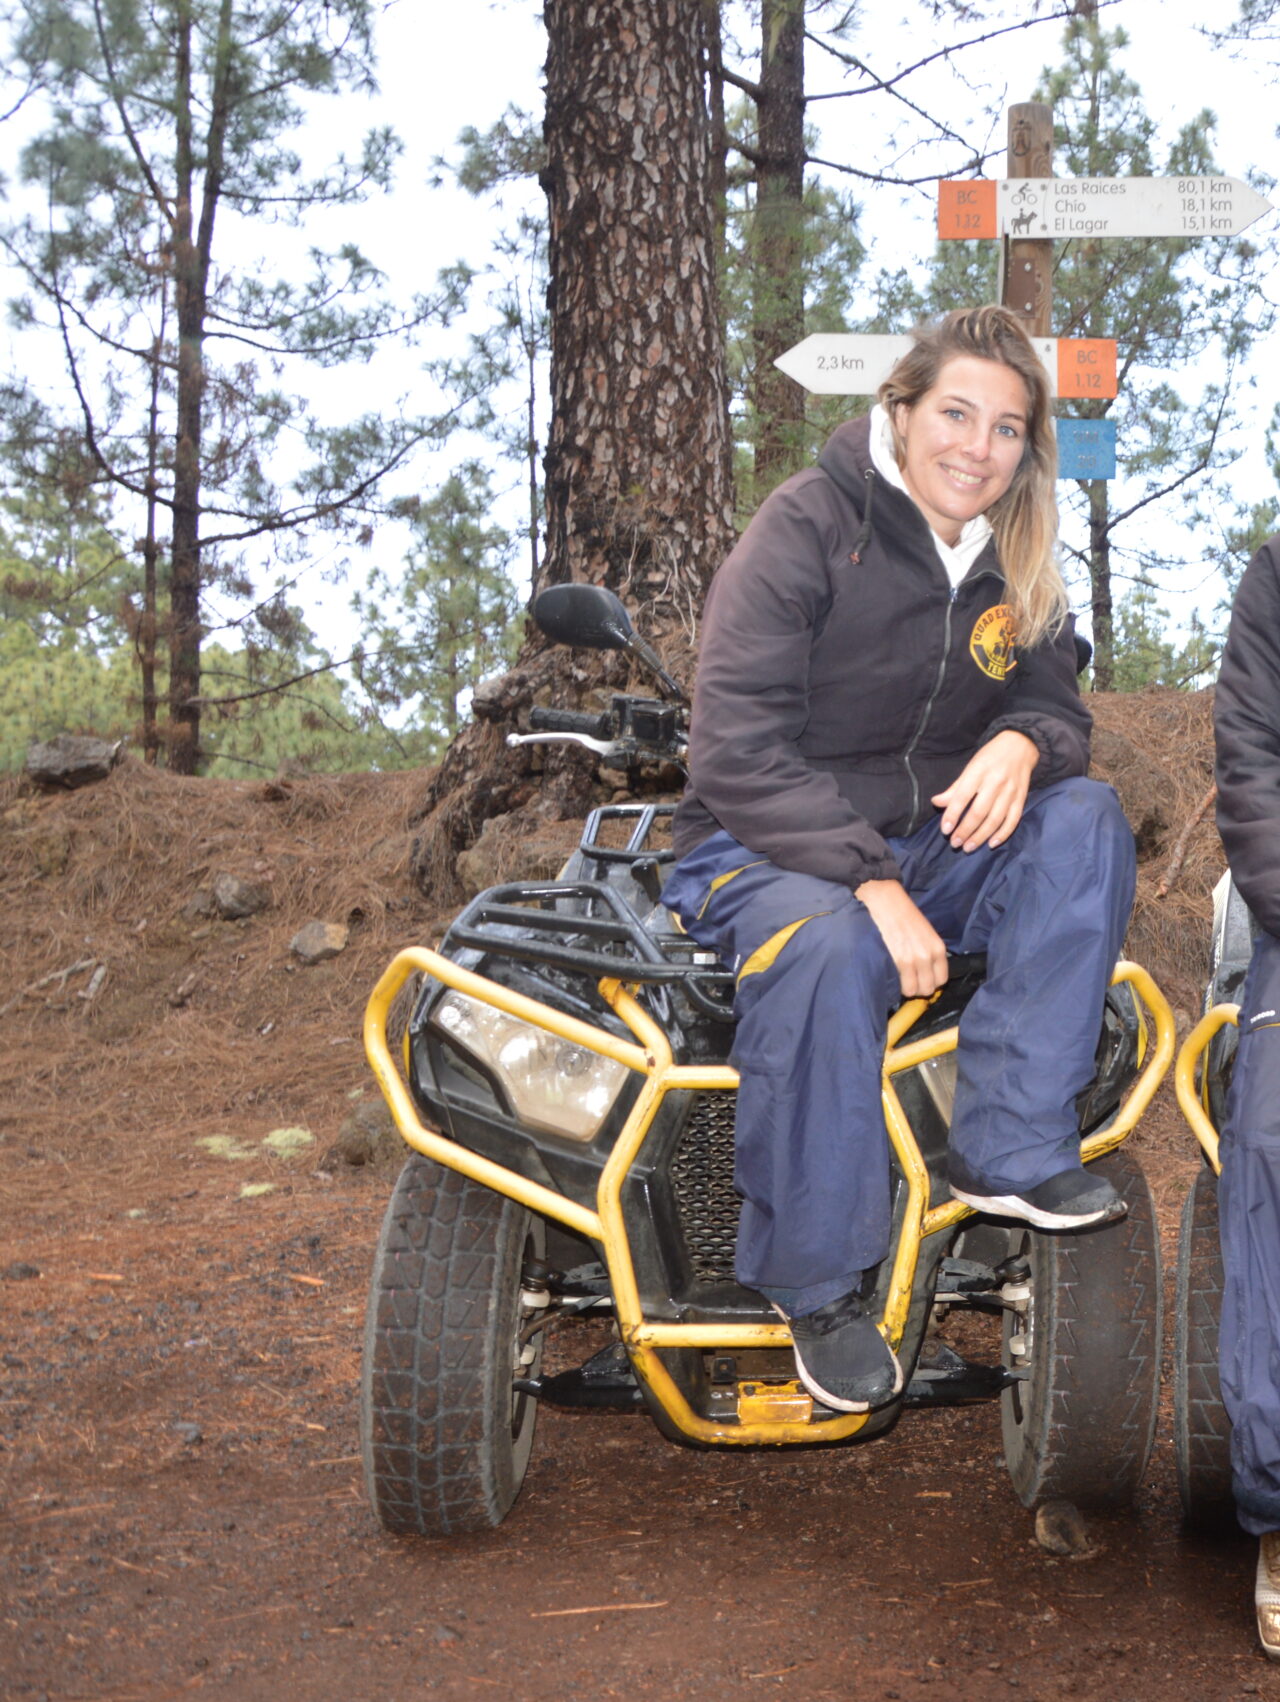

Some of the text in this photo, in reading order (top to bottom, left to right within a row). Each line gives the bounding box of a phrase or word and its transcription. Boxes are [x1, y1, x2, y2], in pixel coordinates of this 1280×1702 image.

[1054, 182, 1078, 195] Las
[1177, 179, 1205, 195] 80,1
[1210, 178, 1232, 193] km
[956, 189, 977, 205] BC
[1181, 197, 1205, 213] 18,1
[1210, 196, 1232, 211] km
[1054, 214, 1232, 234] El Lagar 15,1 km
[817, 354, 864, 371] 2,3 km
[1076, 349, 1097, 364] BC
[1074, 372, 1102, 388] 1.12
[973, 613, 994, 641] QUAD
